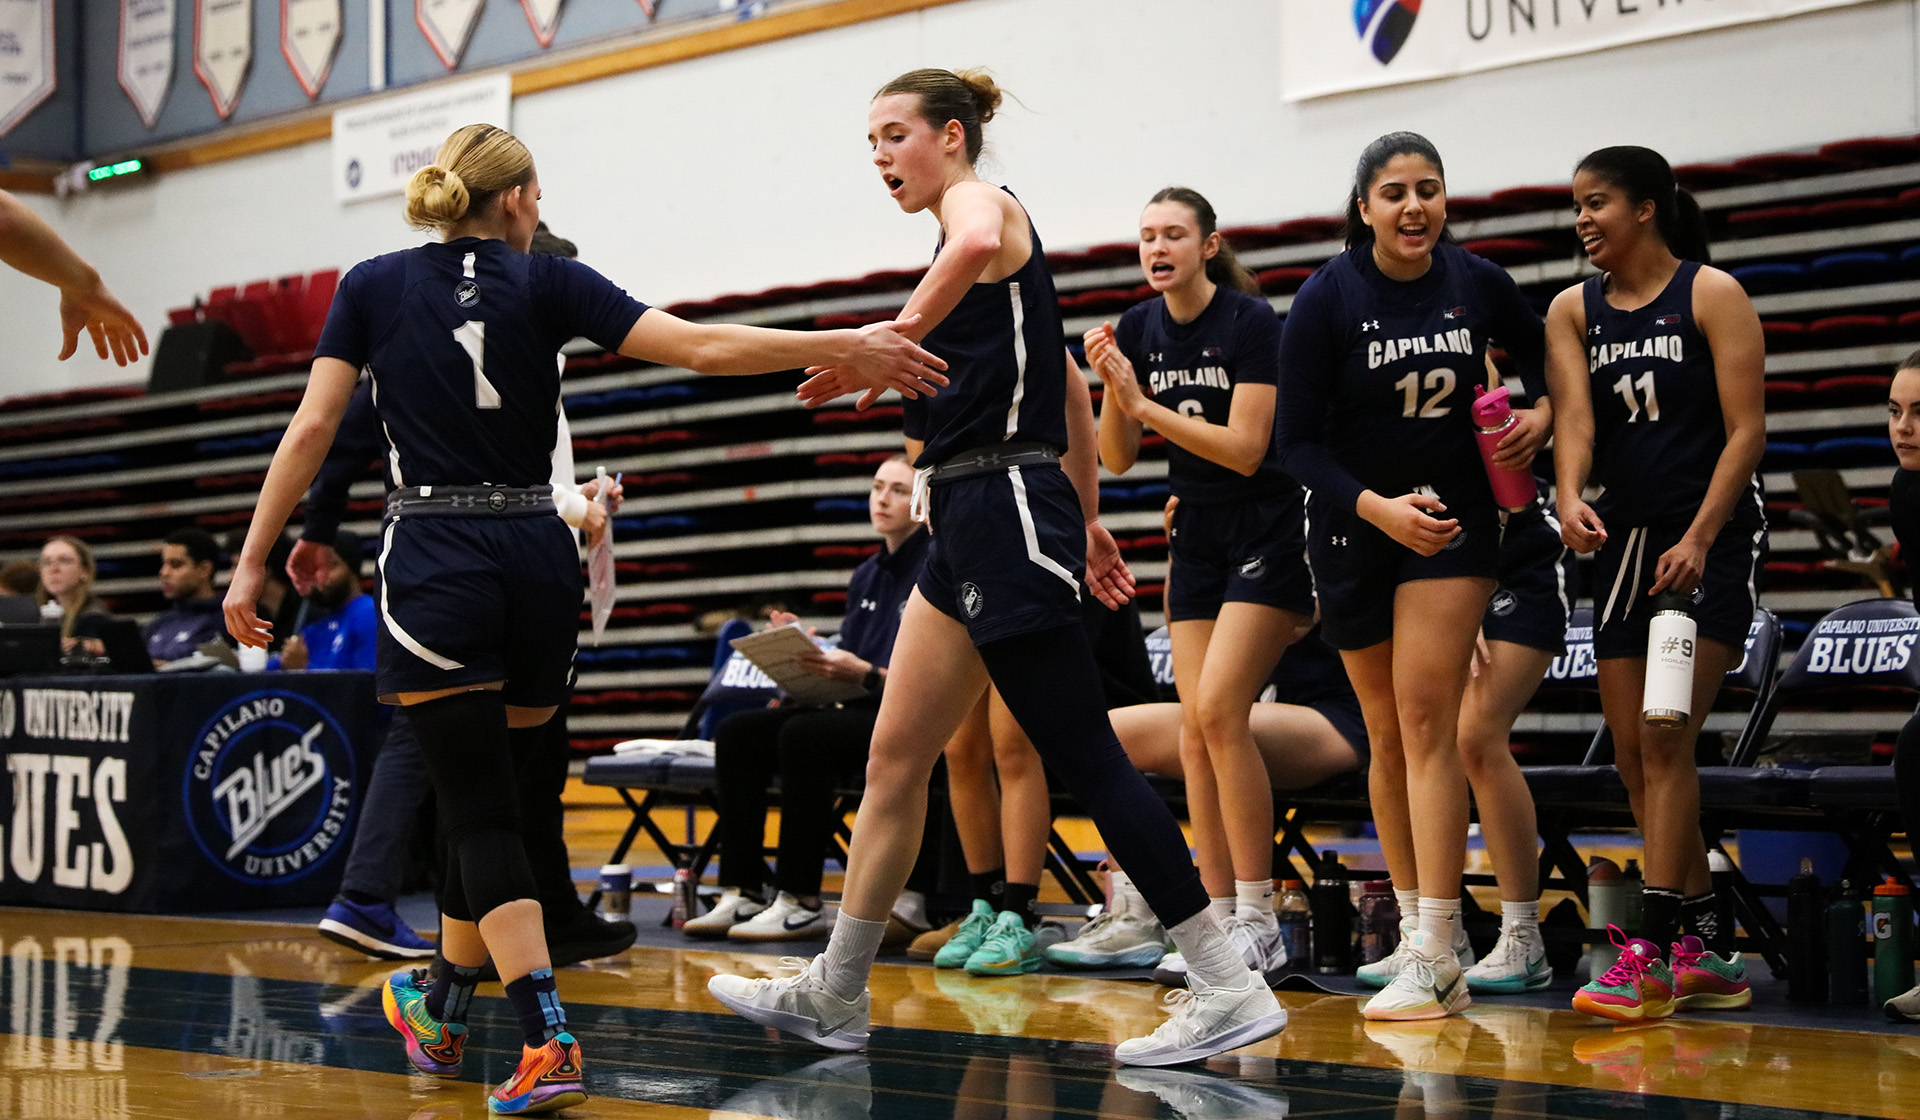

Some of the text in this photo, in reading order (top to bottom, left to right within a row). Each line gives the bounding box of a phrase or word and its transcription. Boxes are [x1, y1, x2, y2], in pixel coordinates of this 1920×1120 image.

[452, 320, 502, 409] 1
[1367, 327, 1473, 370] CAPILANO
[1589, 335, 1683, 374] CAPILANO
[1149, 366, 1231, 396] CAPILANO
[1395, 367, 1457, 418] 12
[1613, 370, 1660, 423] 11
[1660, 636, 1693, 658] #9
[1818, 620, 1866, 634] CAPILANO
[1806, 633, 1918, 674] BLUES
[23, 688, 135, 743] UNIVERSITY
[194, 698, 285, 780] CAPILANO
[0, 752, 135, 895] UES
[244, 776, 351, 877] UNIVERSITY
